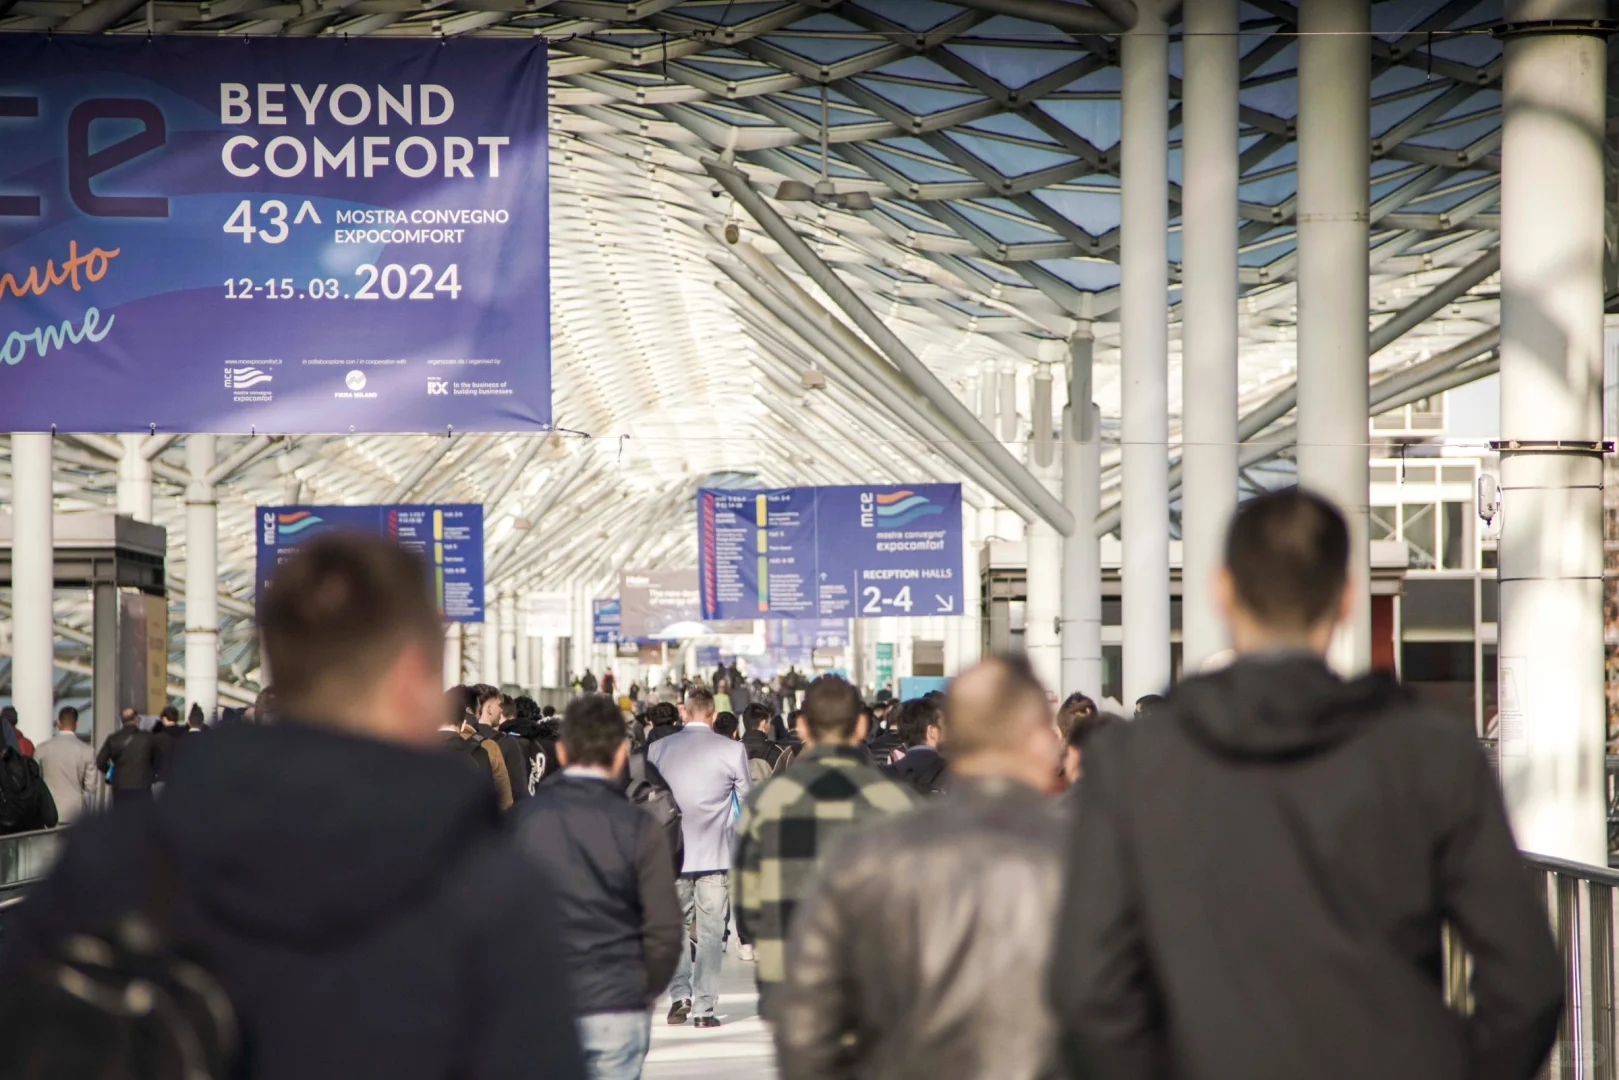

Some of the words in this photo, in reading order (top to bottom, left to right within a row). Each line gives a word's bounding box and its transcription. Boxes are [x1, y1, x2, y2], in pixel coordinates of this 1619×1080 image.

[220, 82, 455, 126] BEYOND
[221, 136, 510, 178] COMFORT
[336, 209, 408, 224] MOSTRA
[411, 209, 509, 224] CONVEGNO
[334, 229, 465, 243] EXPOCOMFORT
[223, 367, 233, 388] mce
[427, 381, 449, 395] RX
[860, 492, 874, 528] mce
[263, 511, 276, 546] mce
[876, 531, 903, 540] mostra
[876, 540, 945, 553] expocomfort
[863, 569, 918, 580] RECEPTION
[922, 568, 953, 579] HALLS
[863, 585, 914, 613] 2-4
